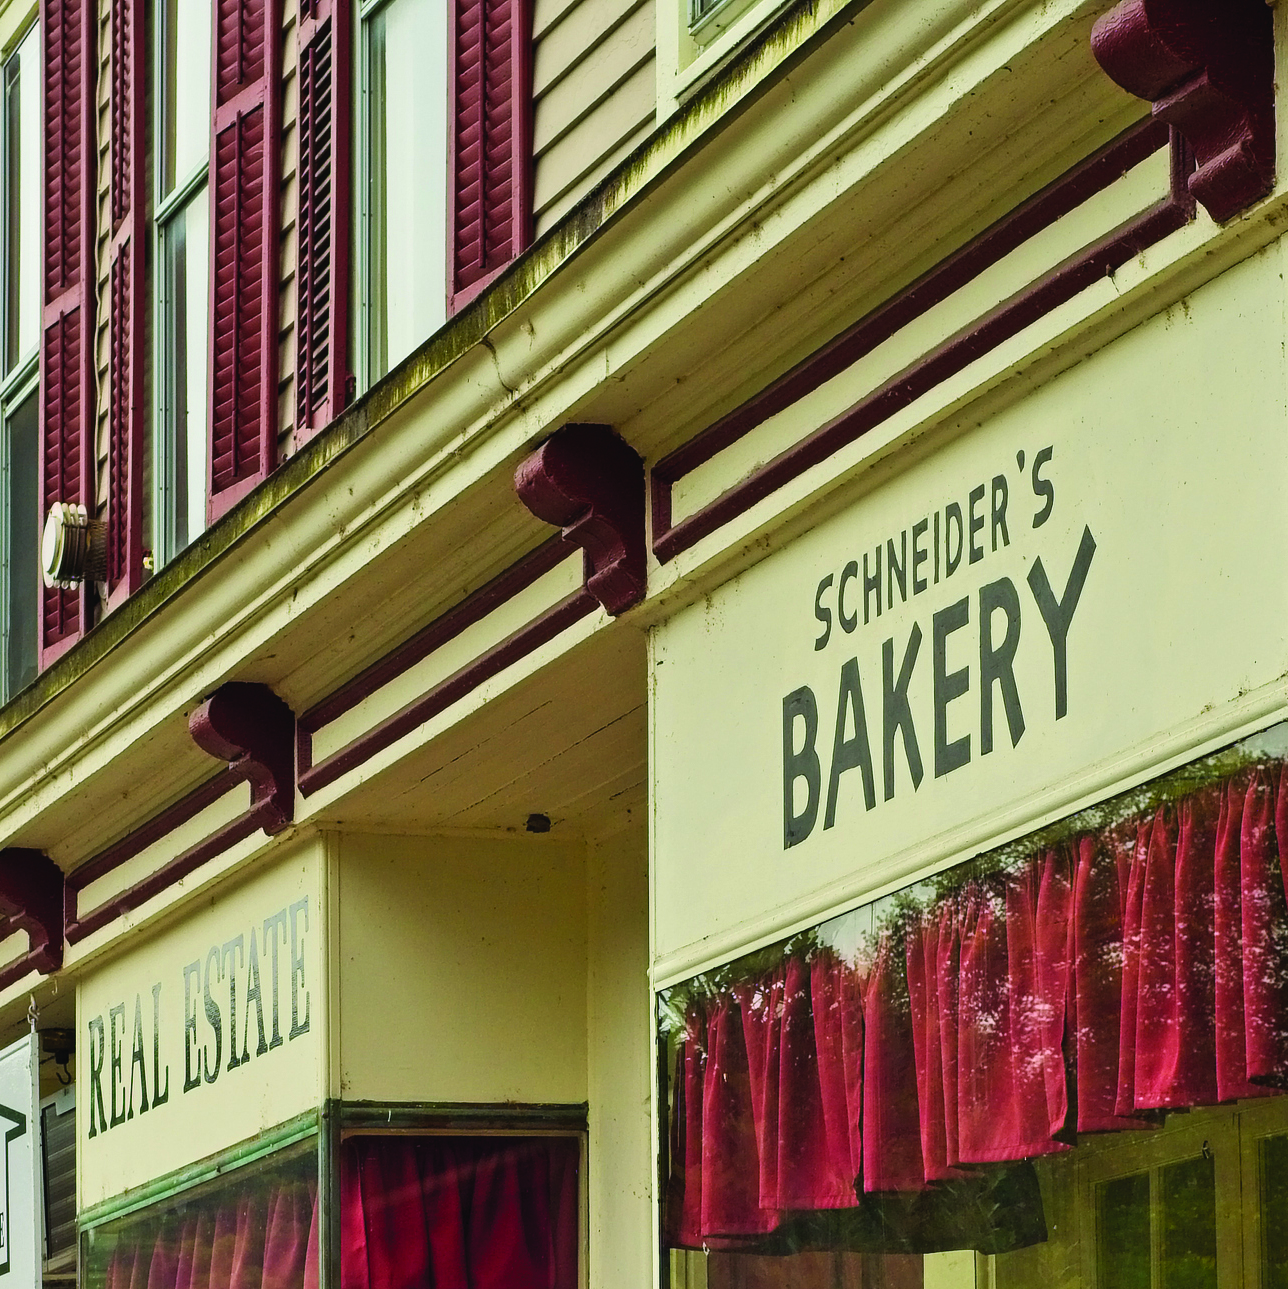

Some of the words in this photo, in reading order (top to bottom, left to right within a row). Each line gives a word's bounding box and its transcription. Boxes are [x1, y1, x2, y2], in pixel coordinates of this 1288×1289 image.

[814, 444, 1054, 652] SCHNEIDER'S
[782, 523, 1097, 850] BAKERY
[88, 981, 169, 1140] REAL
[183, 894, 311, 1094] ESTATE
